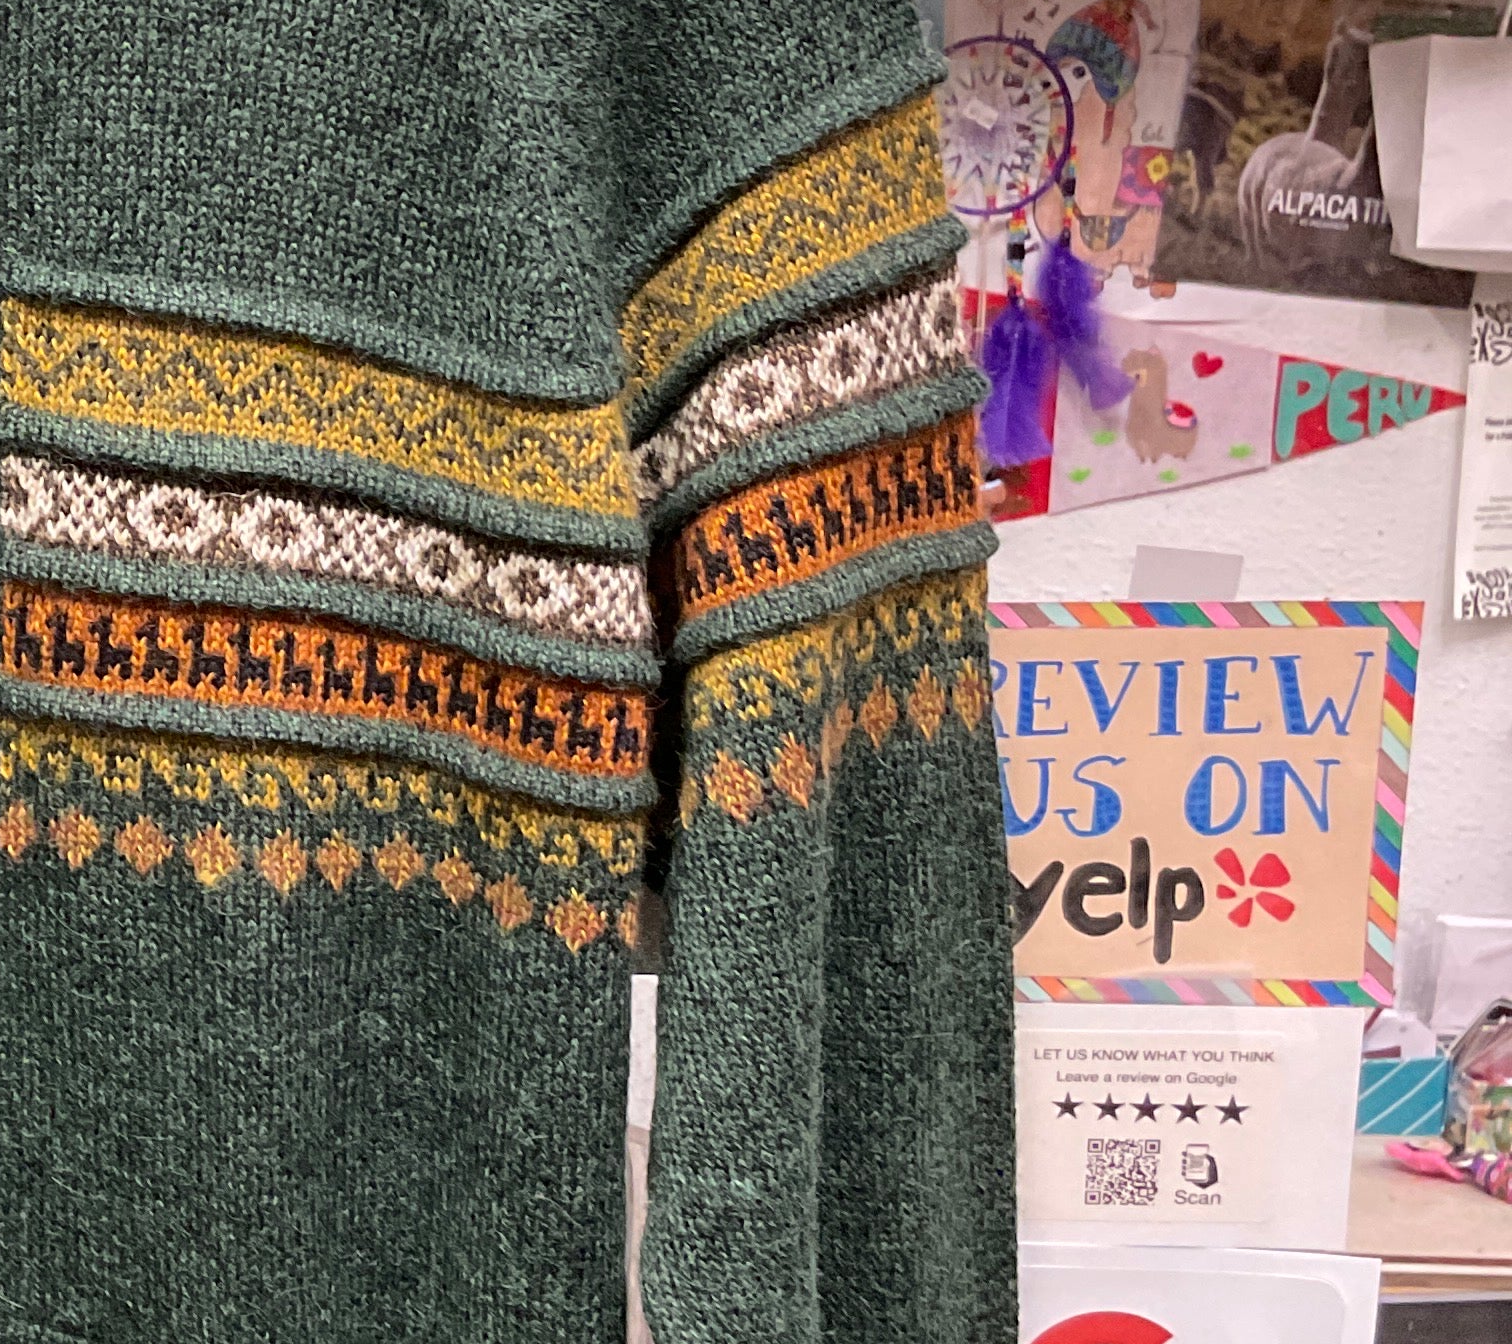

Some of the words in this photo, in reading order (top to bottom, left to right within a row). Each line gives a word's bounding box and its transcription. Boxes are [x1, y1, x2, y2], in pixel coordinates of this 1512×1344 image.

[1268, 189, 1358, 222] ALPACA
[1275, 362, 1431, 459] PERU
[1000, 755, 1126, 837] US
[1184, 755, 1340, 836] ON
[1009, 837, 1205, 964] yelp
[1034, 1049, 1062, 1061] LET
[1066, 1049, 1088, 1061] US
[1092, 1050, 1139, 1061] KNOW
[1143, 1050, 1188, 1062] WHAT
[1191, 1050, 1224, 1062] YOU
[1229, 1051, 1275, 1063] THINK
[1056, 1070, 1099, 1084] Leave
[1103, 1073, 1112, 1084] a
[1116, 1071, 1160, 1084] review
[1164, 1074, 1182, 1084] on
[1186, 1071, 1237, 1087] Google
[1174, 1190, 1222, 1206] Scan
